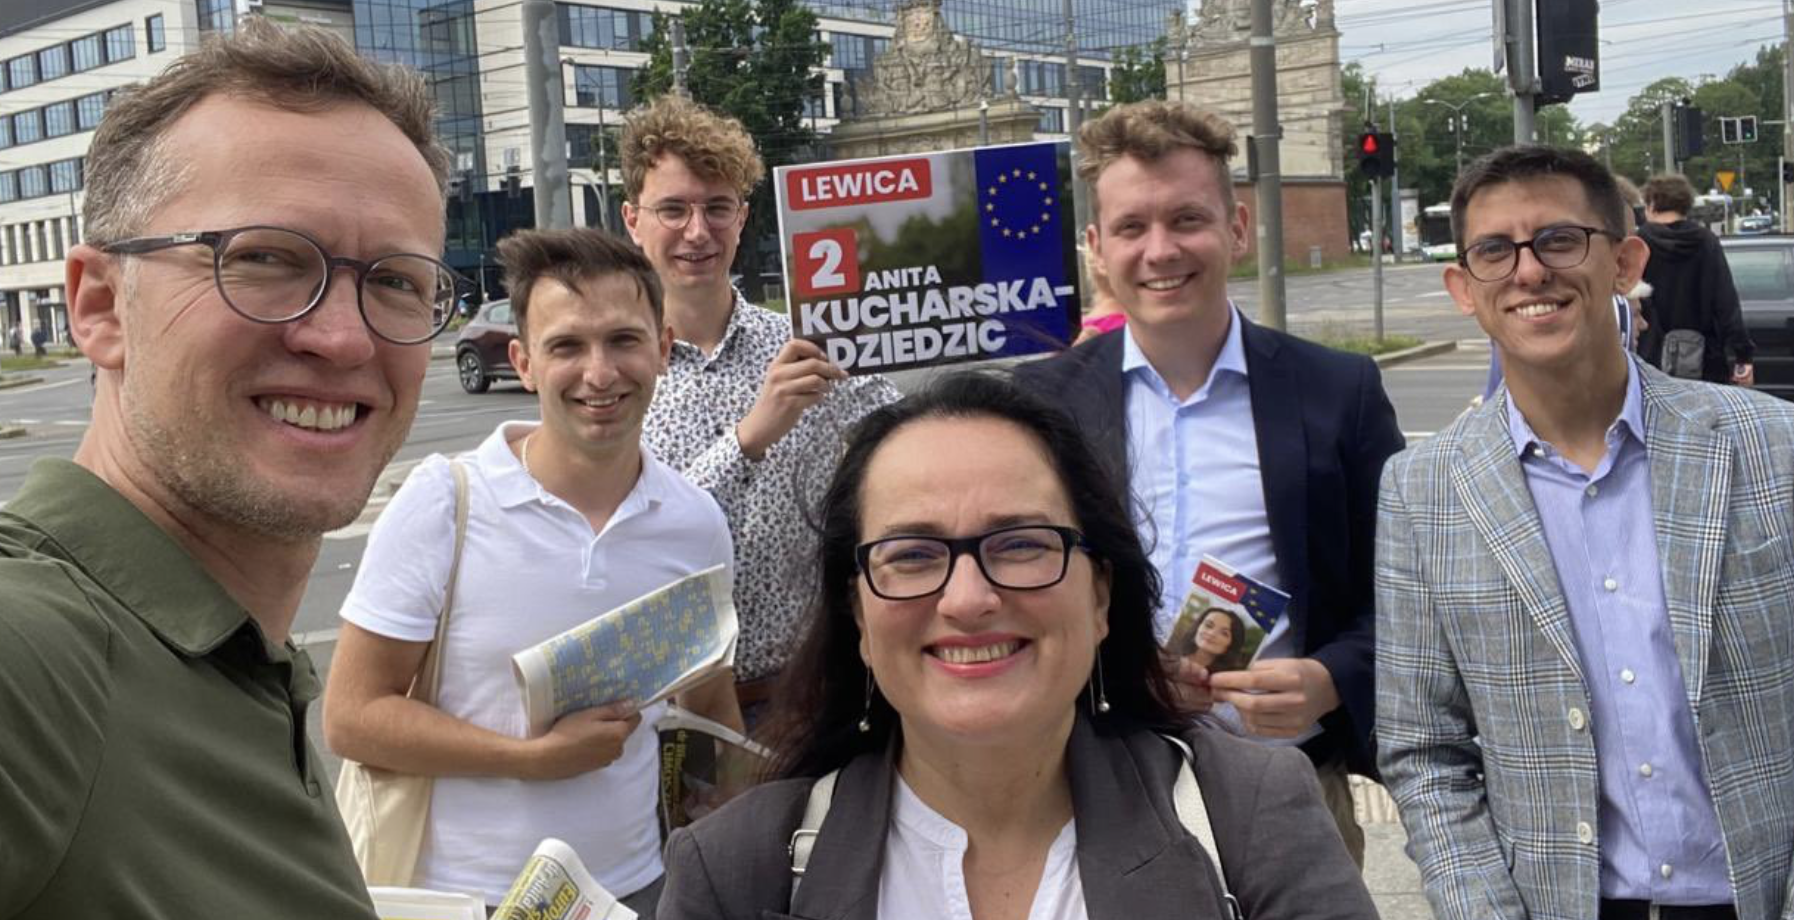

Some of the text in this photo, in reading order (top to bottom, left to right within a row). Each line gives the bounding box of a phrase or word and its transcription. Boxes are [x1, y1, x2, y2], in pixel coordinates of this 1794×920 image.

[801, 168, 919, 202] LEWICA
[808, 238, 846, 289] 2
[864, 265, 942, 292] ANITA
[800, 277, 1075, 336] KUCHARSKA-
[826, 319, 1007, 371] DZIEDZIC
[1201, 572, 1238, 596] LEWICA
